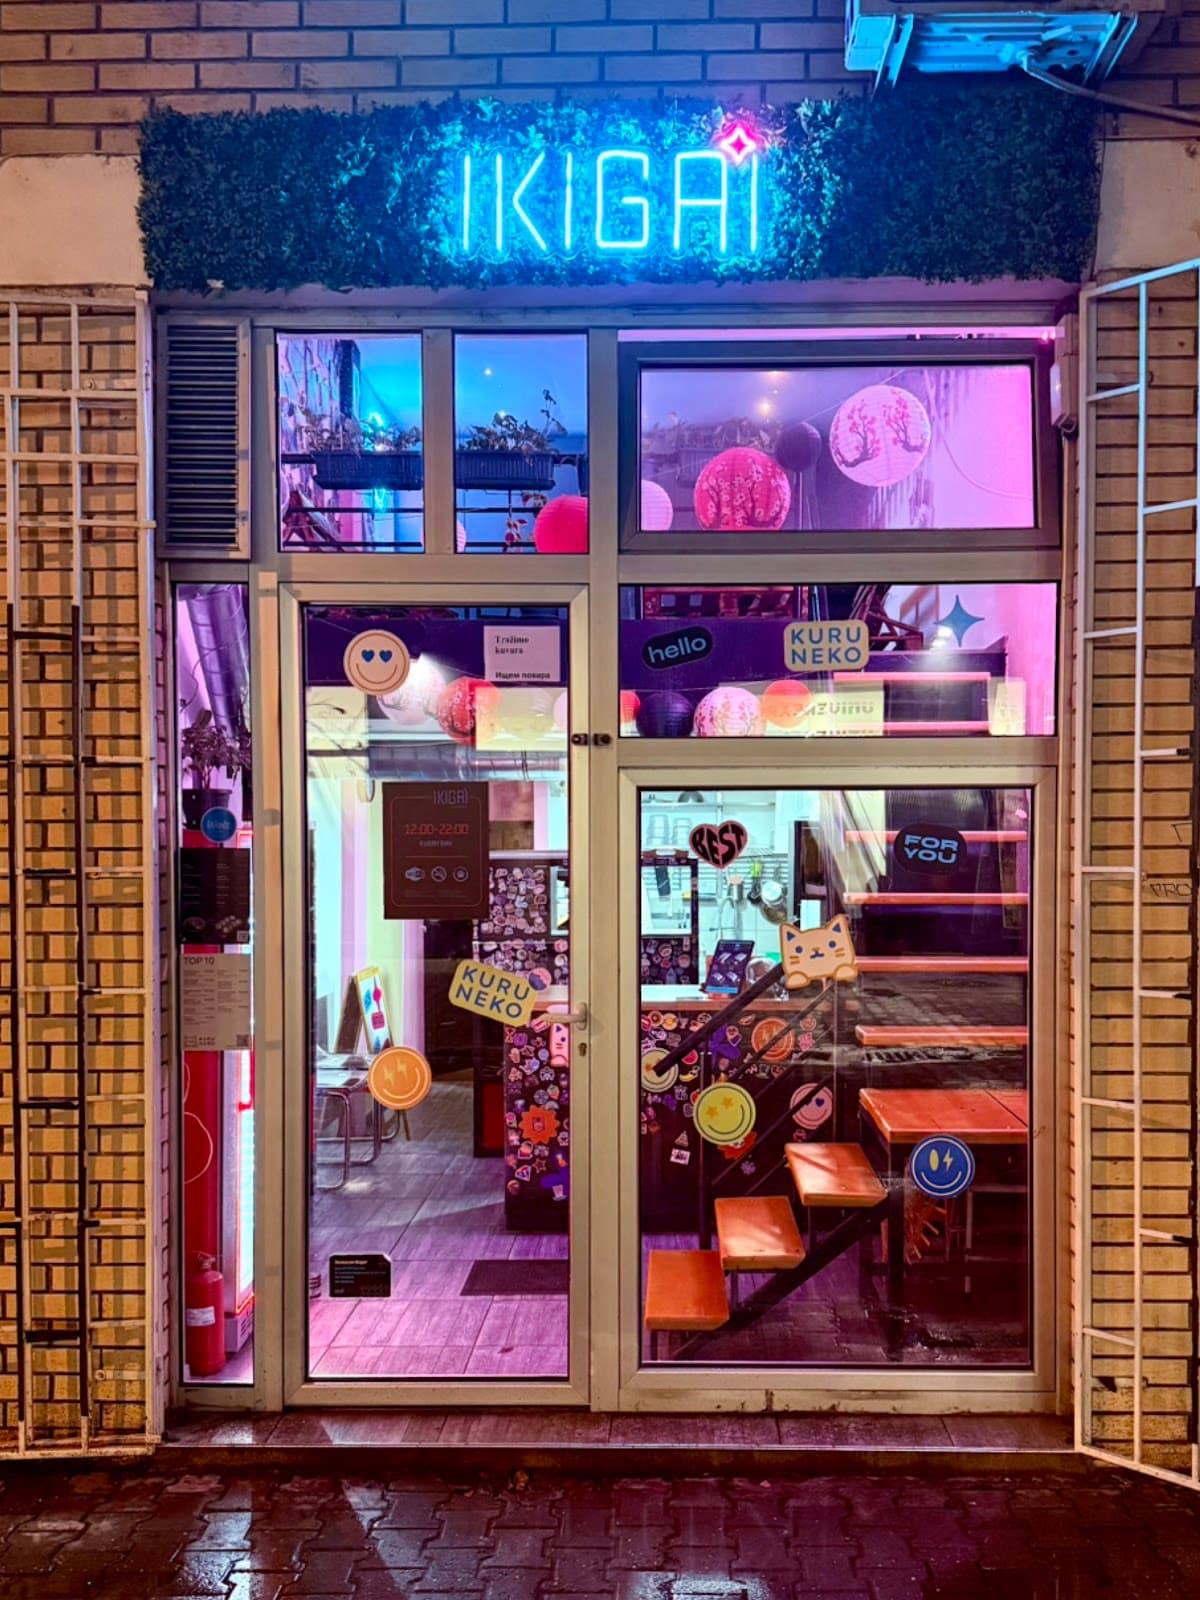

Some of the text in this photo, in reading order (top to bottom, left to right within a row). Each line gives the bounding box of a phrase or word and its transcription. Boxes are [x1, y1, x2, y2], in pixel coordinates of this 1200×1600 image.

[463, 150, 758, 253] IKIGAI
[791, 626, 861, 645] KURU
[648, 636, 707, 663] hello
[791, 647, 862, 665] NEKO
[495, 672, 551, 680] Ищем повара
[433, 786, 469, 805] IKIGAI
[691, 823, 745, 866] BEST
[904, 834, 959, 851] FOR
[903, 847, 957, 864] YOU
[184, 957, 215, 966] TOP 10
[462, 965, 530, 1001] KURU
[456, 983, 522, 1018] NEKO
